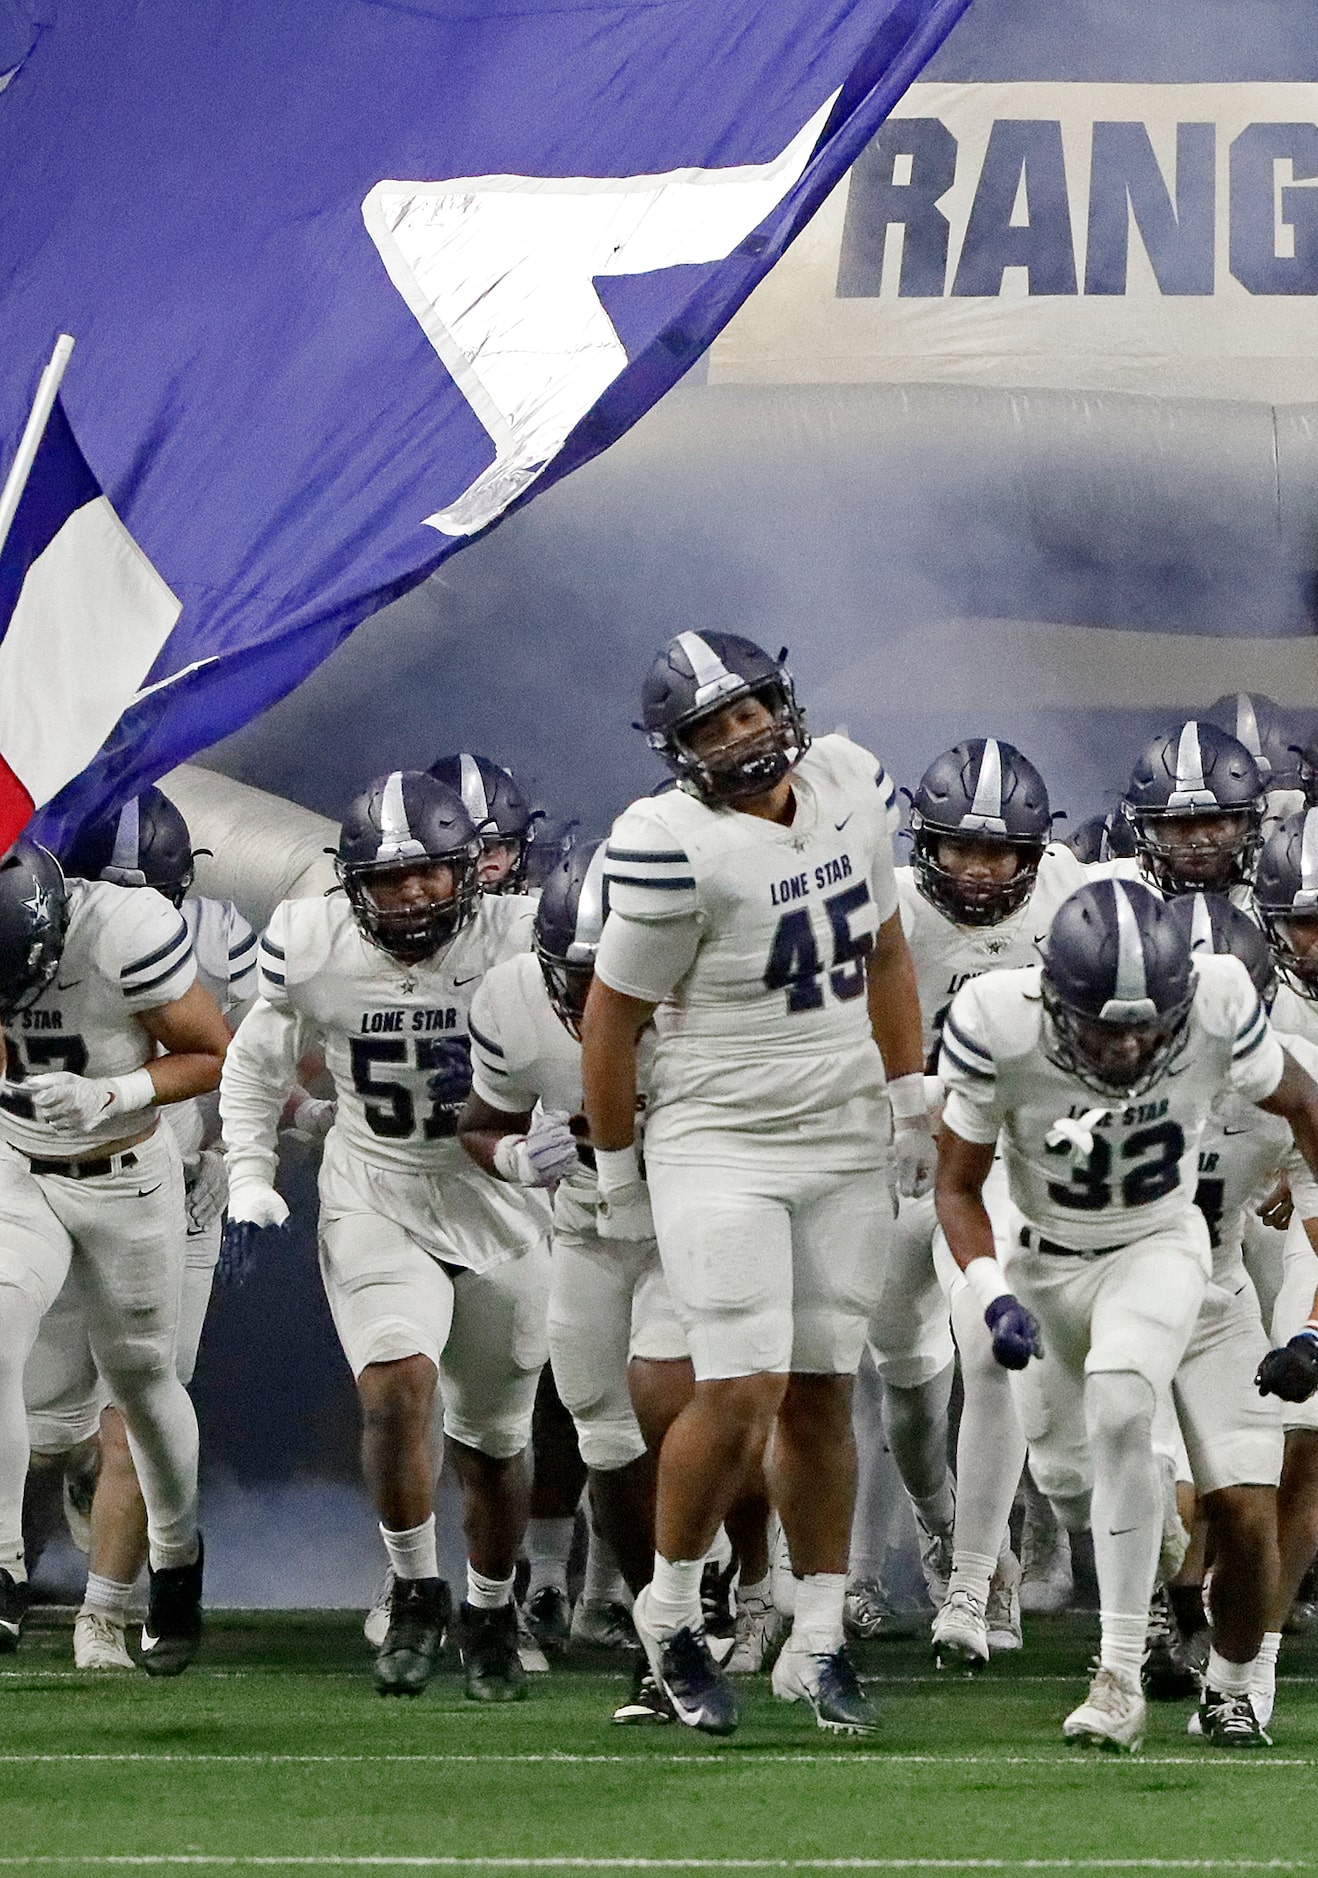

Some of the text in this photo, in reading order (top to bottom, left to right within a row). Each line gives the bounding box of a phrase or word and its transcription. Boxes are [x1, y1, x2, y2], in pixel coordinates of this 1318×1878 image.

[770, 853, 853, 906] LONE STAR
[763, 877, 874, 1014] 45
[22, 1008, 63, 1030] STAR
[361, 1008, 457, 1034] LONE STAR
[1123, 1099, 1169, 1126] STAR
[1045, 1120, 1186, 1210] 32
